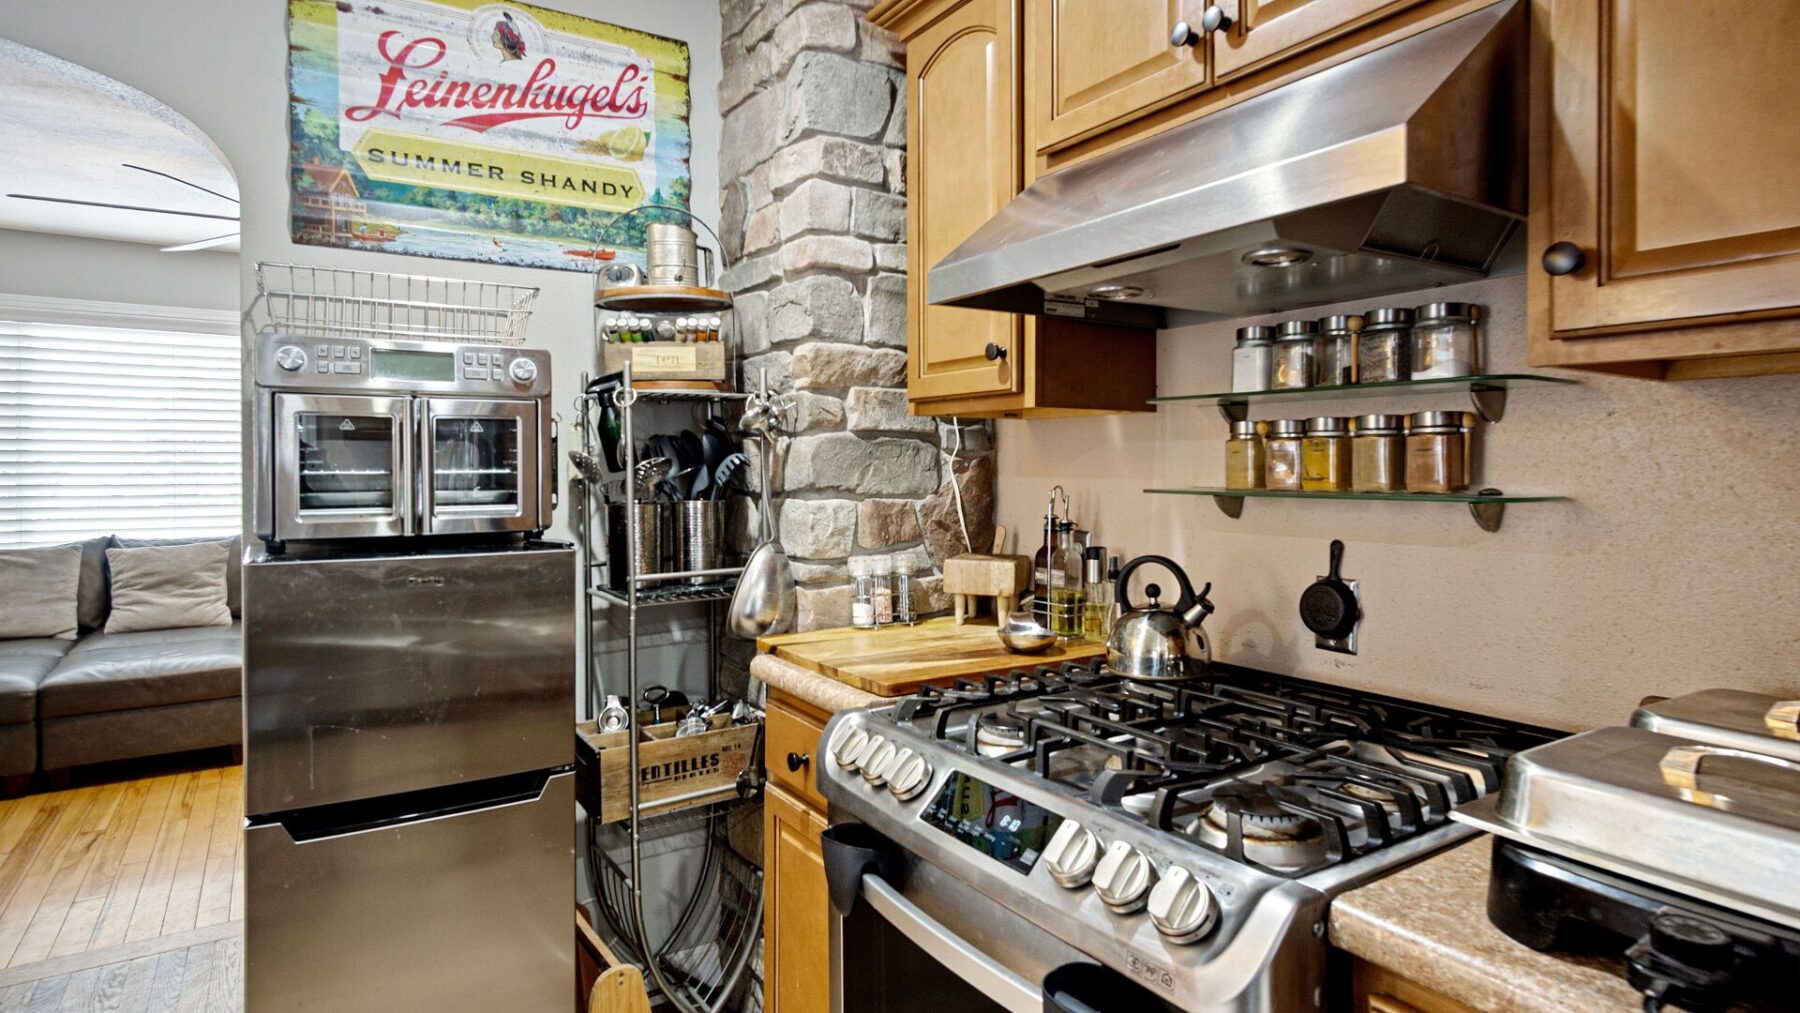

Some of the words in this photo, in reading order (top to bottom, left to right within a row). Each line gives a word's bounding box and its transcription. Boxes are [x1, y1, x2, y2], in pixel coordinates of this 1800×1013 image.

[345, 30, 648, 130] Leinenkugel's
[368, 148, 504, 181] SUMMER
[521, 171, 634, 199] SHANDY
[640, 753, 720, 782] ENTILLES
